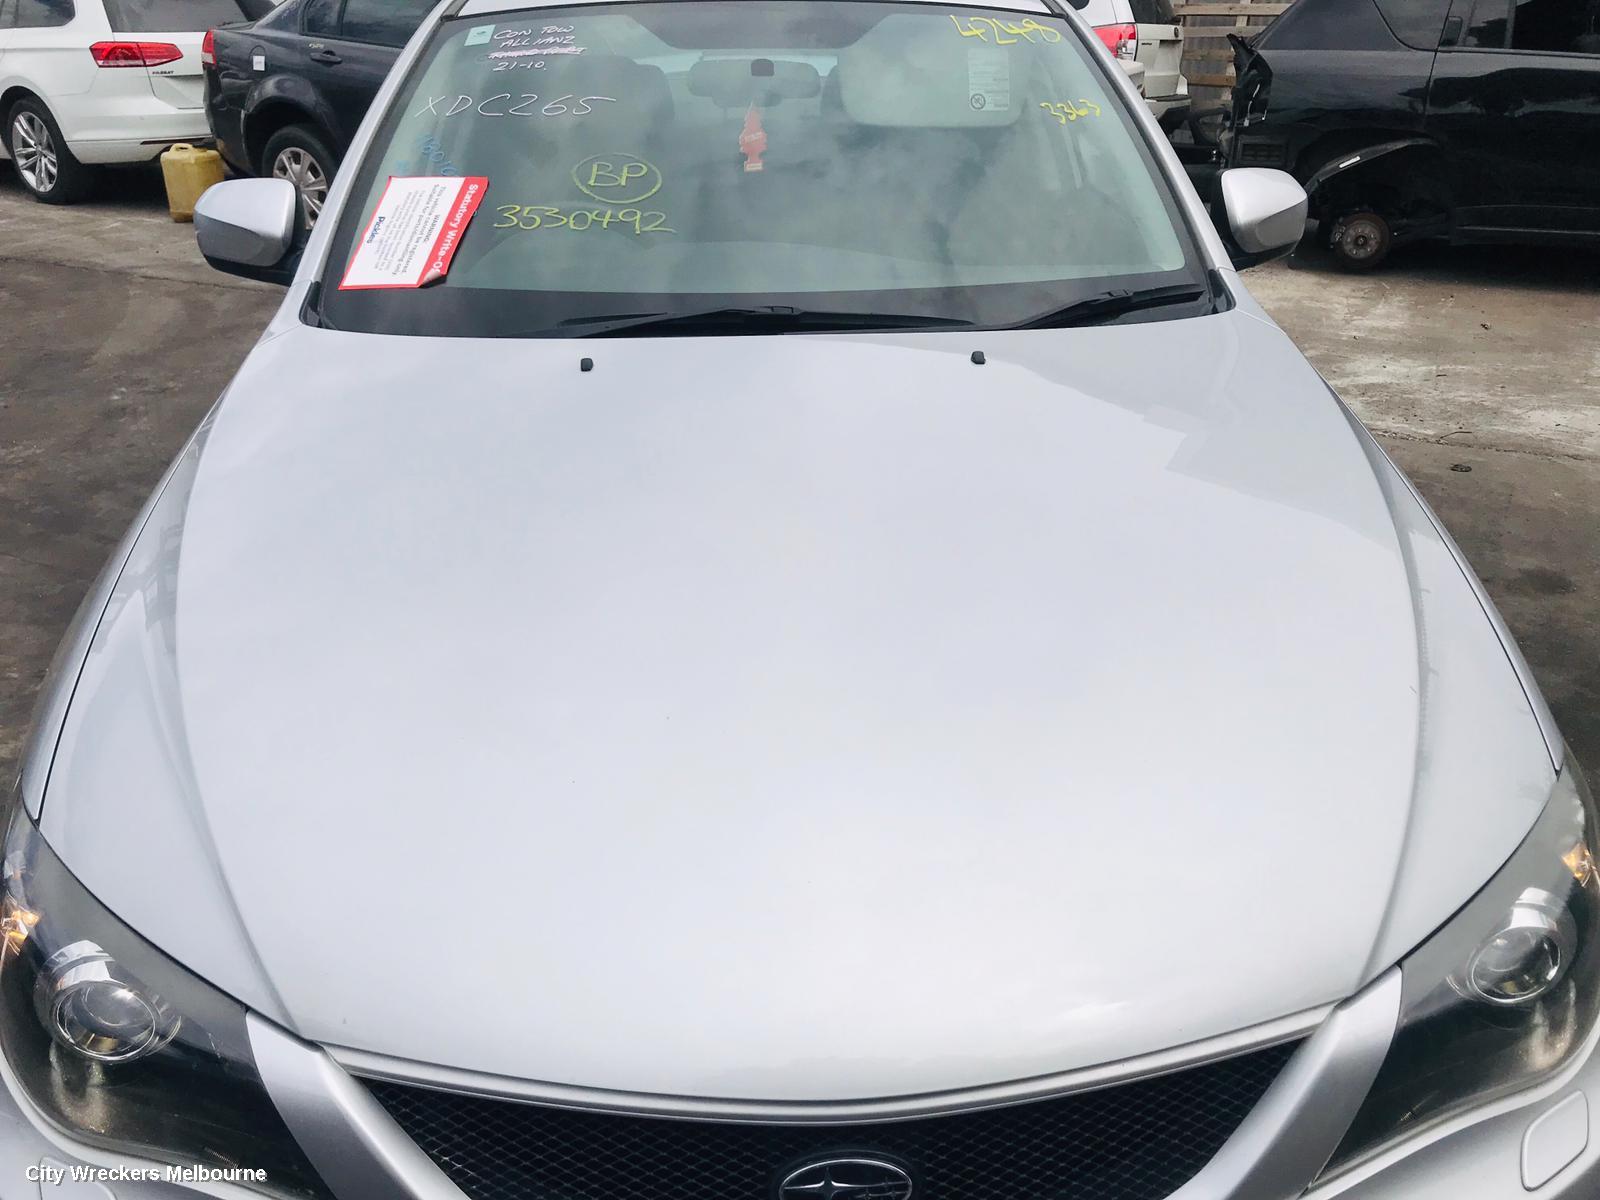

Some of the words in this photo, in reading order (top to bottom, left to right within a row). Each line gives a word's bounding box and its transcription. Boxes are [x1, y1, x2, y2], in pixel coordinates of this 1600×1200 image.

[494, 29, 531, 39] CON
[541, 25, 574, 34] TOW
[950, 15, 1061, 44] 4248
[414, 94, 616, 117] XDC265
[588, 162, 648, 187] BP
[450, 184, 478, 228] Statutory
[493, 205, 677, 234] 3530492
[367, 216, 385, 243] Pickles
